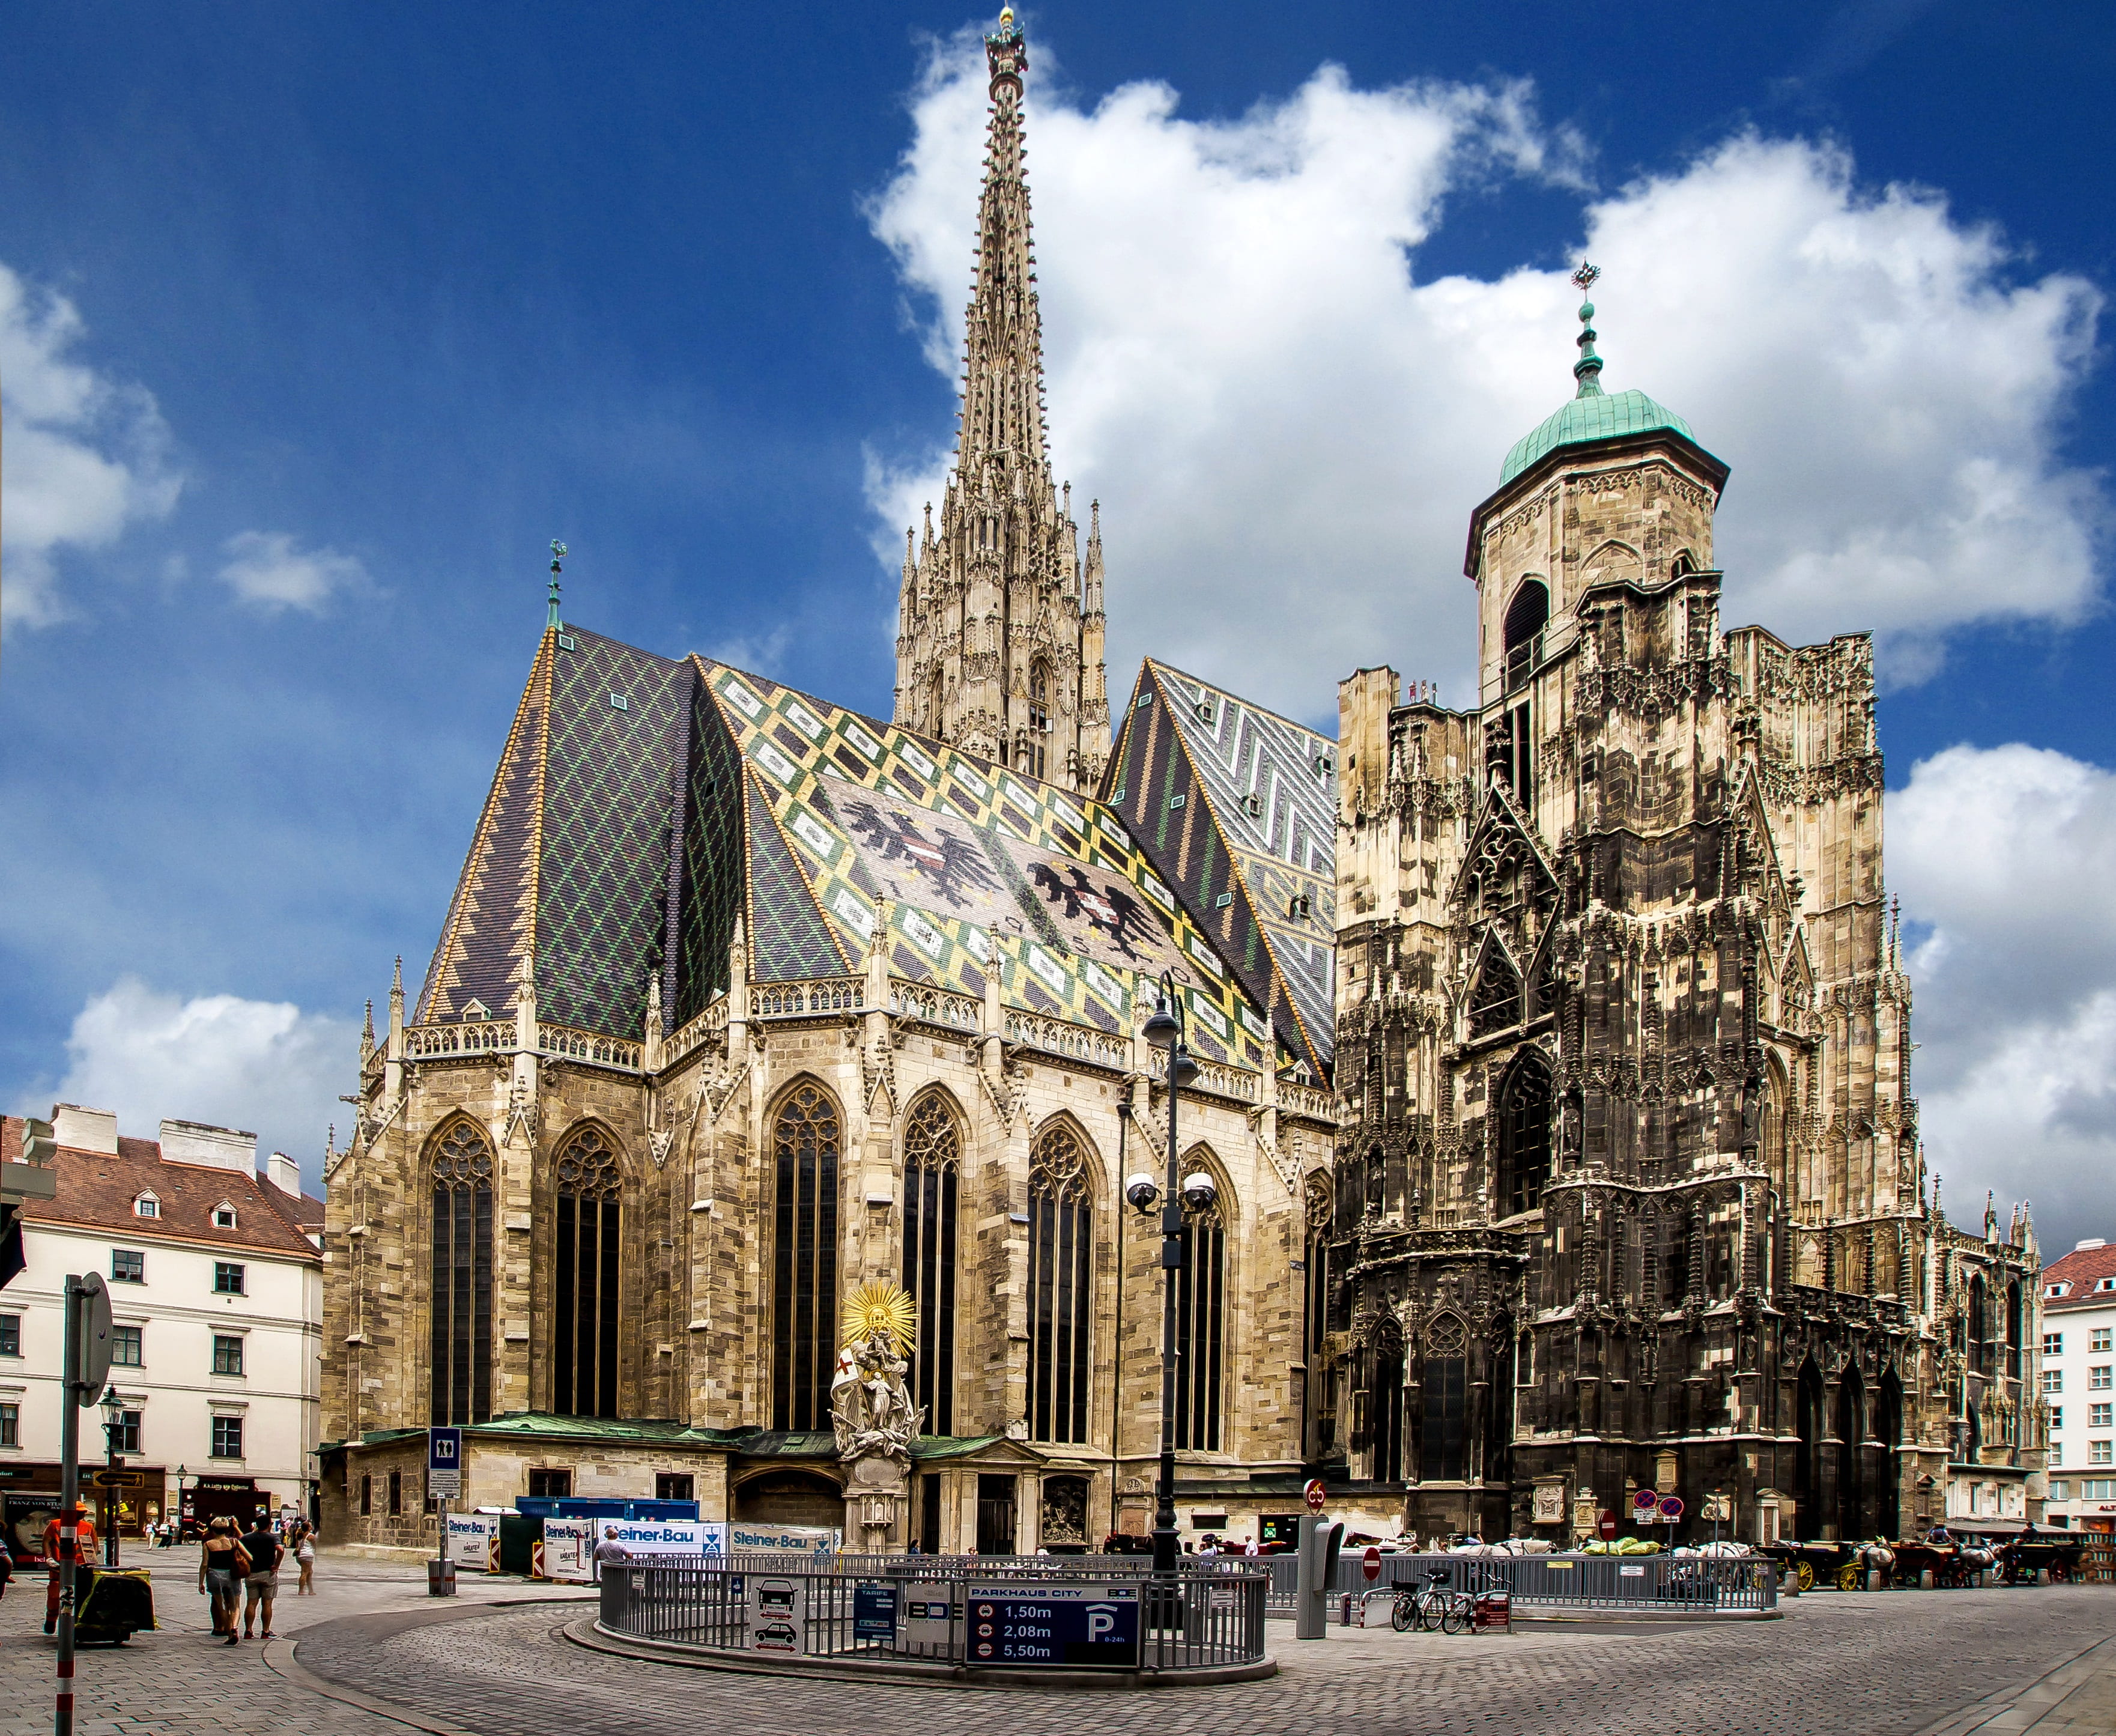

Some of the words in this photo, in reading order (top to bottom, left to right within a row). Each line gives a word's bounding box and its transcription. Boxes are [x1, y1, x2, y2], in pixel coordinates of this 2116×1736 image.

[971, 1589, 1047, 1597] PARKHAUS
[1005, 1606, 1051, 1619] 1,50m
[1004, 1625, 1051, 1639] 2,08m
[1088, 1613, 1114, 1642] P
[1004, 1645, 1050, 1658] 5,50m
